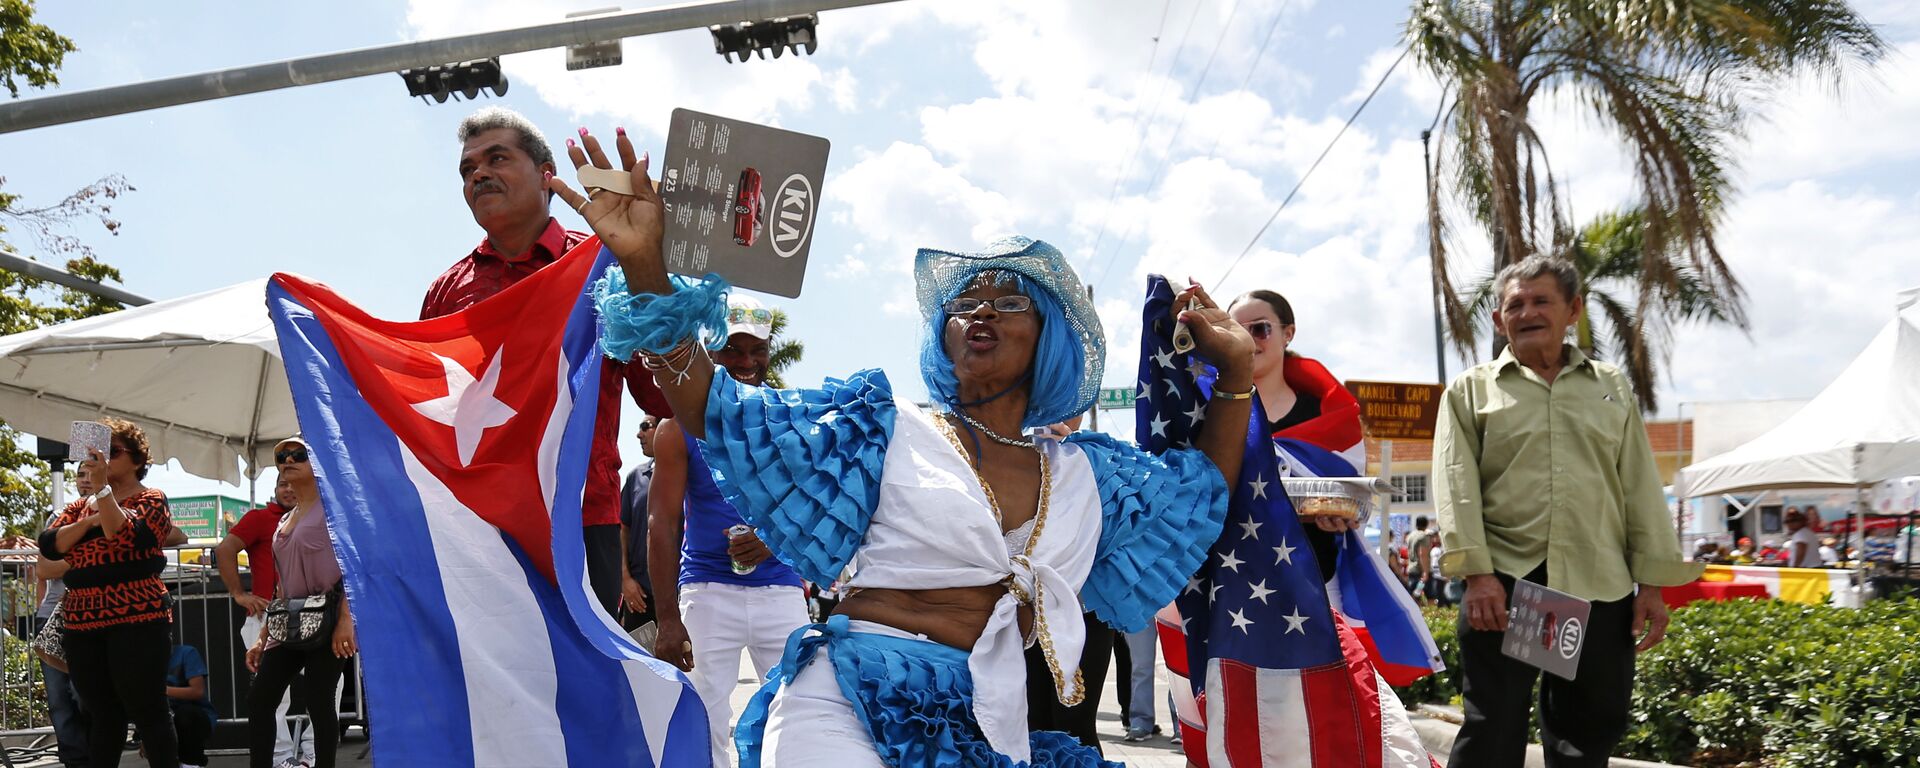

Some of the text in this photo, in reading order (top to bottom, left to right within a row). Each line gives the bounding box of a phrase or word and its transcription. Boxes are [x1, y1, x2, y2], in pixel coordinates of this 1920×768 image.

[722, 183, 734, 222] 2018 Stinger
[776, 187, 808, 242] KIA
[1099, 391, 1111, 400] SW
[1114, 389, 1122, 399] 8
[1359, 385, 1430, 402] MANUEL CAPO
[1368, 403, 1421, 418] BOULEVARD
[1562, 623, 1579, 651] KIA
